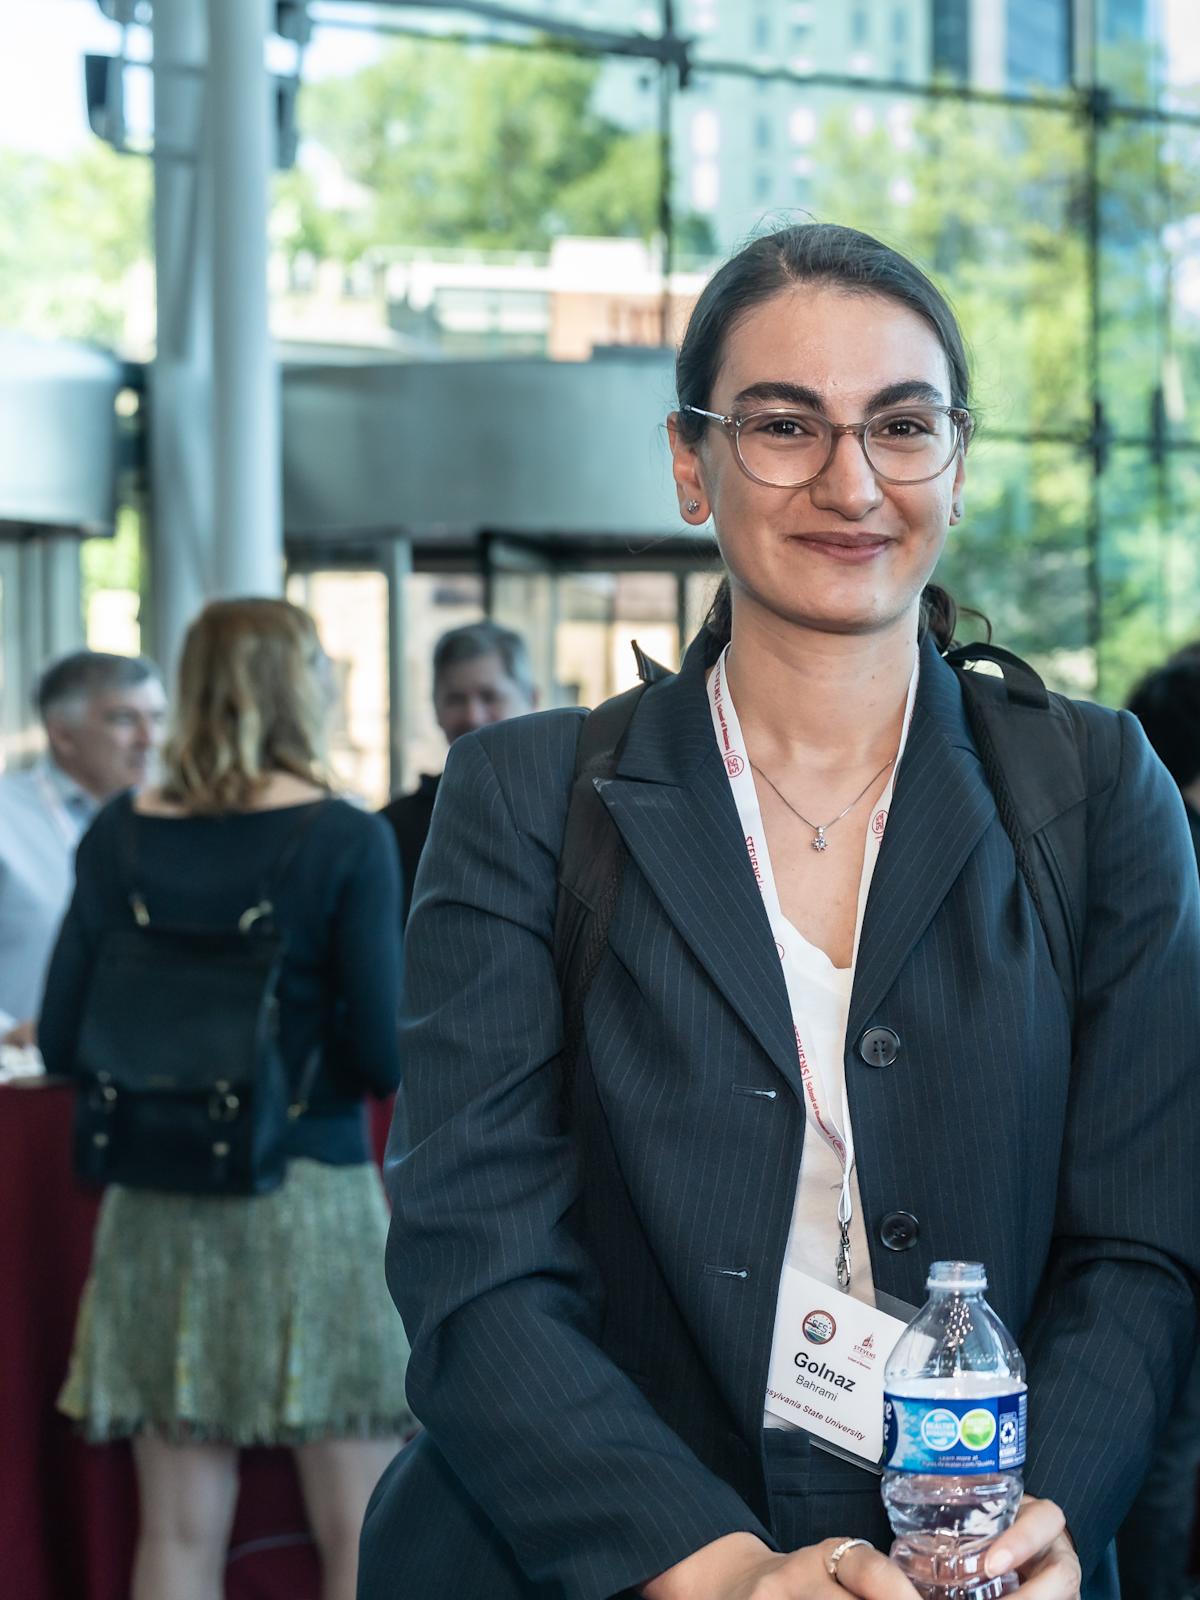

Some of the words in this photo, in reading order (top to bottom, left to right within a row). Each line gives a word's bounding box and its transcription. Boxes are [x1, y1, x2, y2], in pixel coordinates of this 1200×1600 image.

[806, 1081, 817, 1103] School
[853, 1344, 877, 1360] STEVENS
[794, 1352, 856, 1392] Golnaz
[795, 1374, 839, 1402] Bahrami
[803, 1405, 824, 1420] State
[825, 1416, 867, 1441] University
